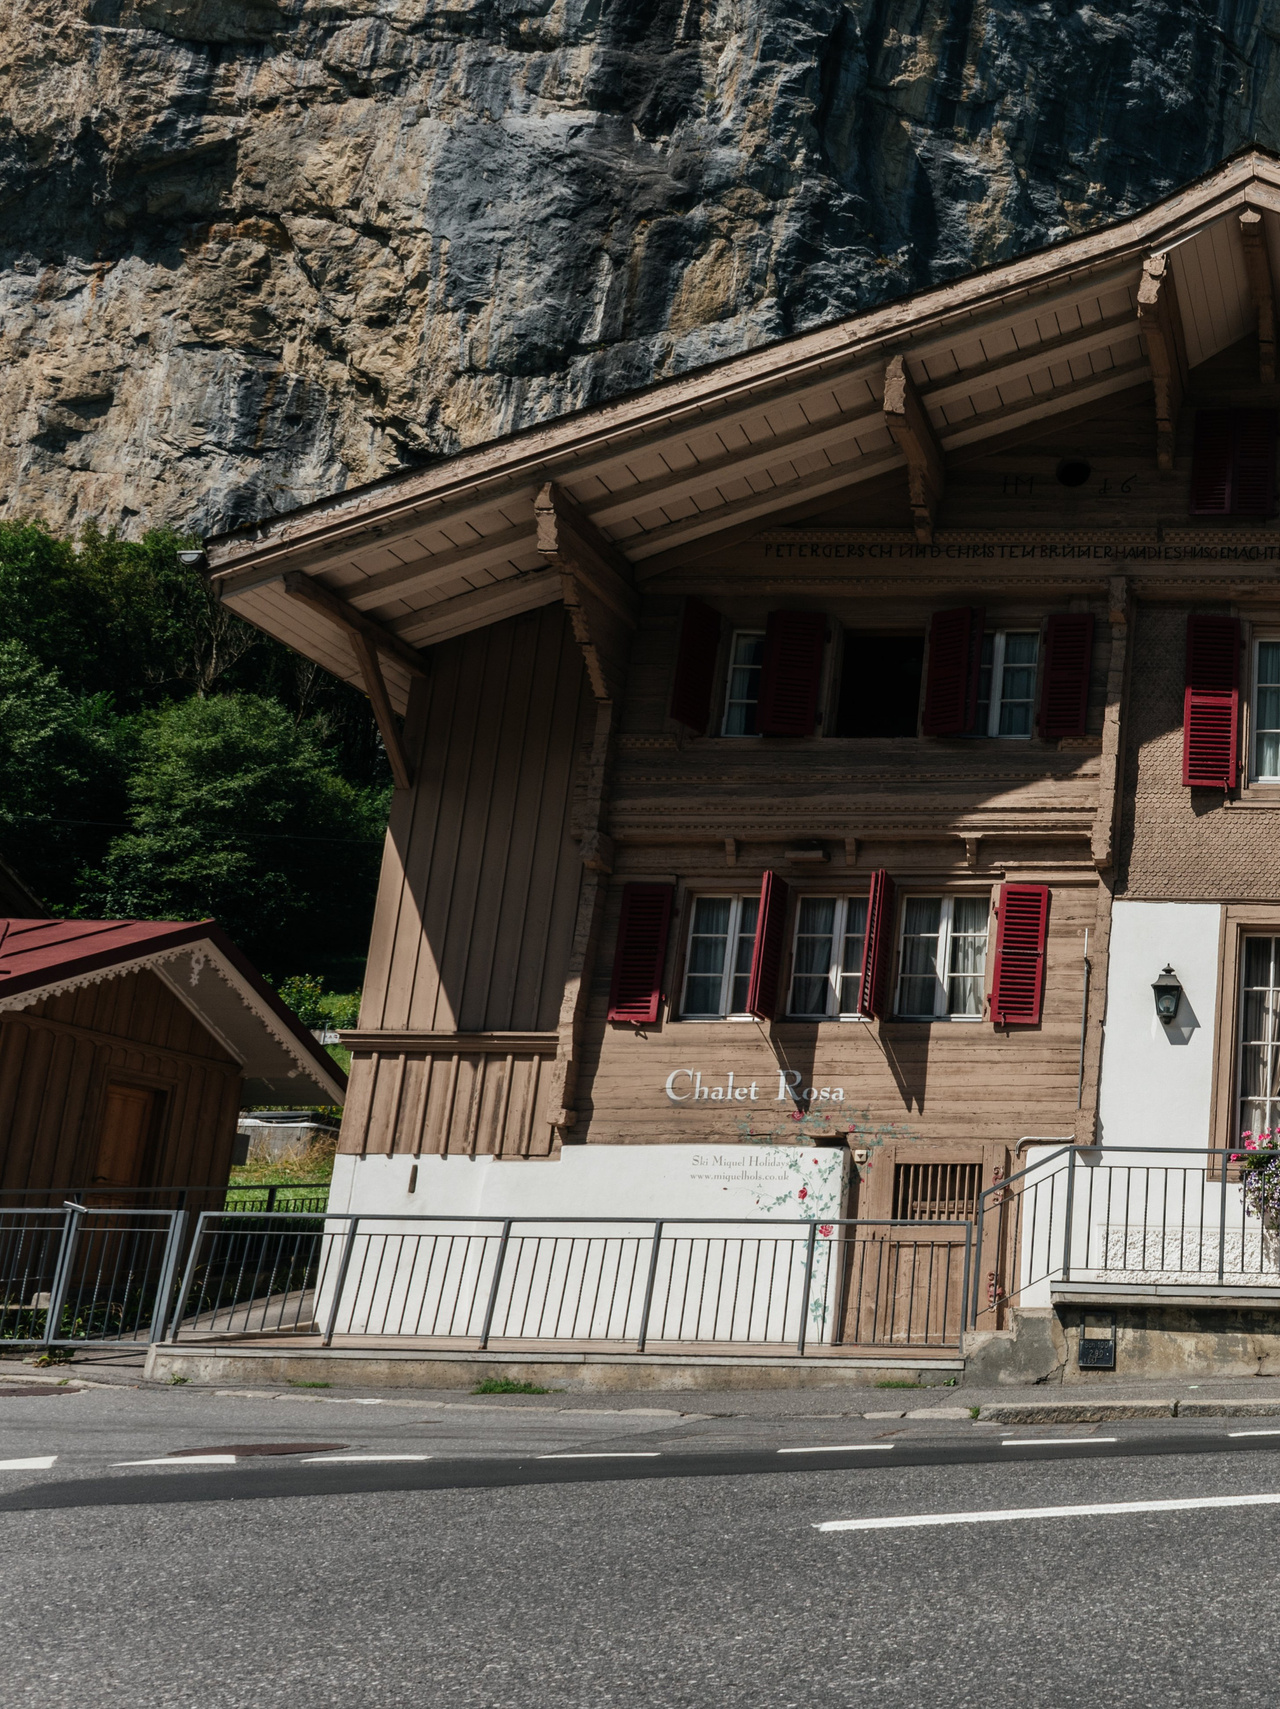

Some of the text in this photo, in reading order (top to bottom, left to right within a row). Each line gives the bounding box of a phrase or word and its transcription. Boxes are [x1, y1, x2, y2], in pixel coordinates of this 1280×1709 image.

[665, 1067, 846, 1101] Chalet Rosa
[692, 1154, 790, 1169] Ski Miquel Holidays
[690, 1170, 790, 1182] www.miquelhols.co.uk
